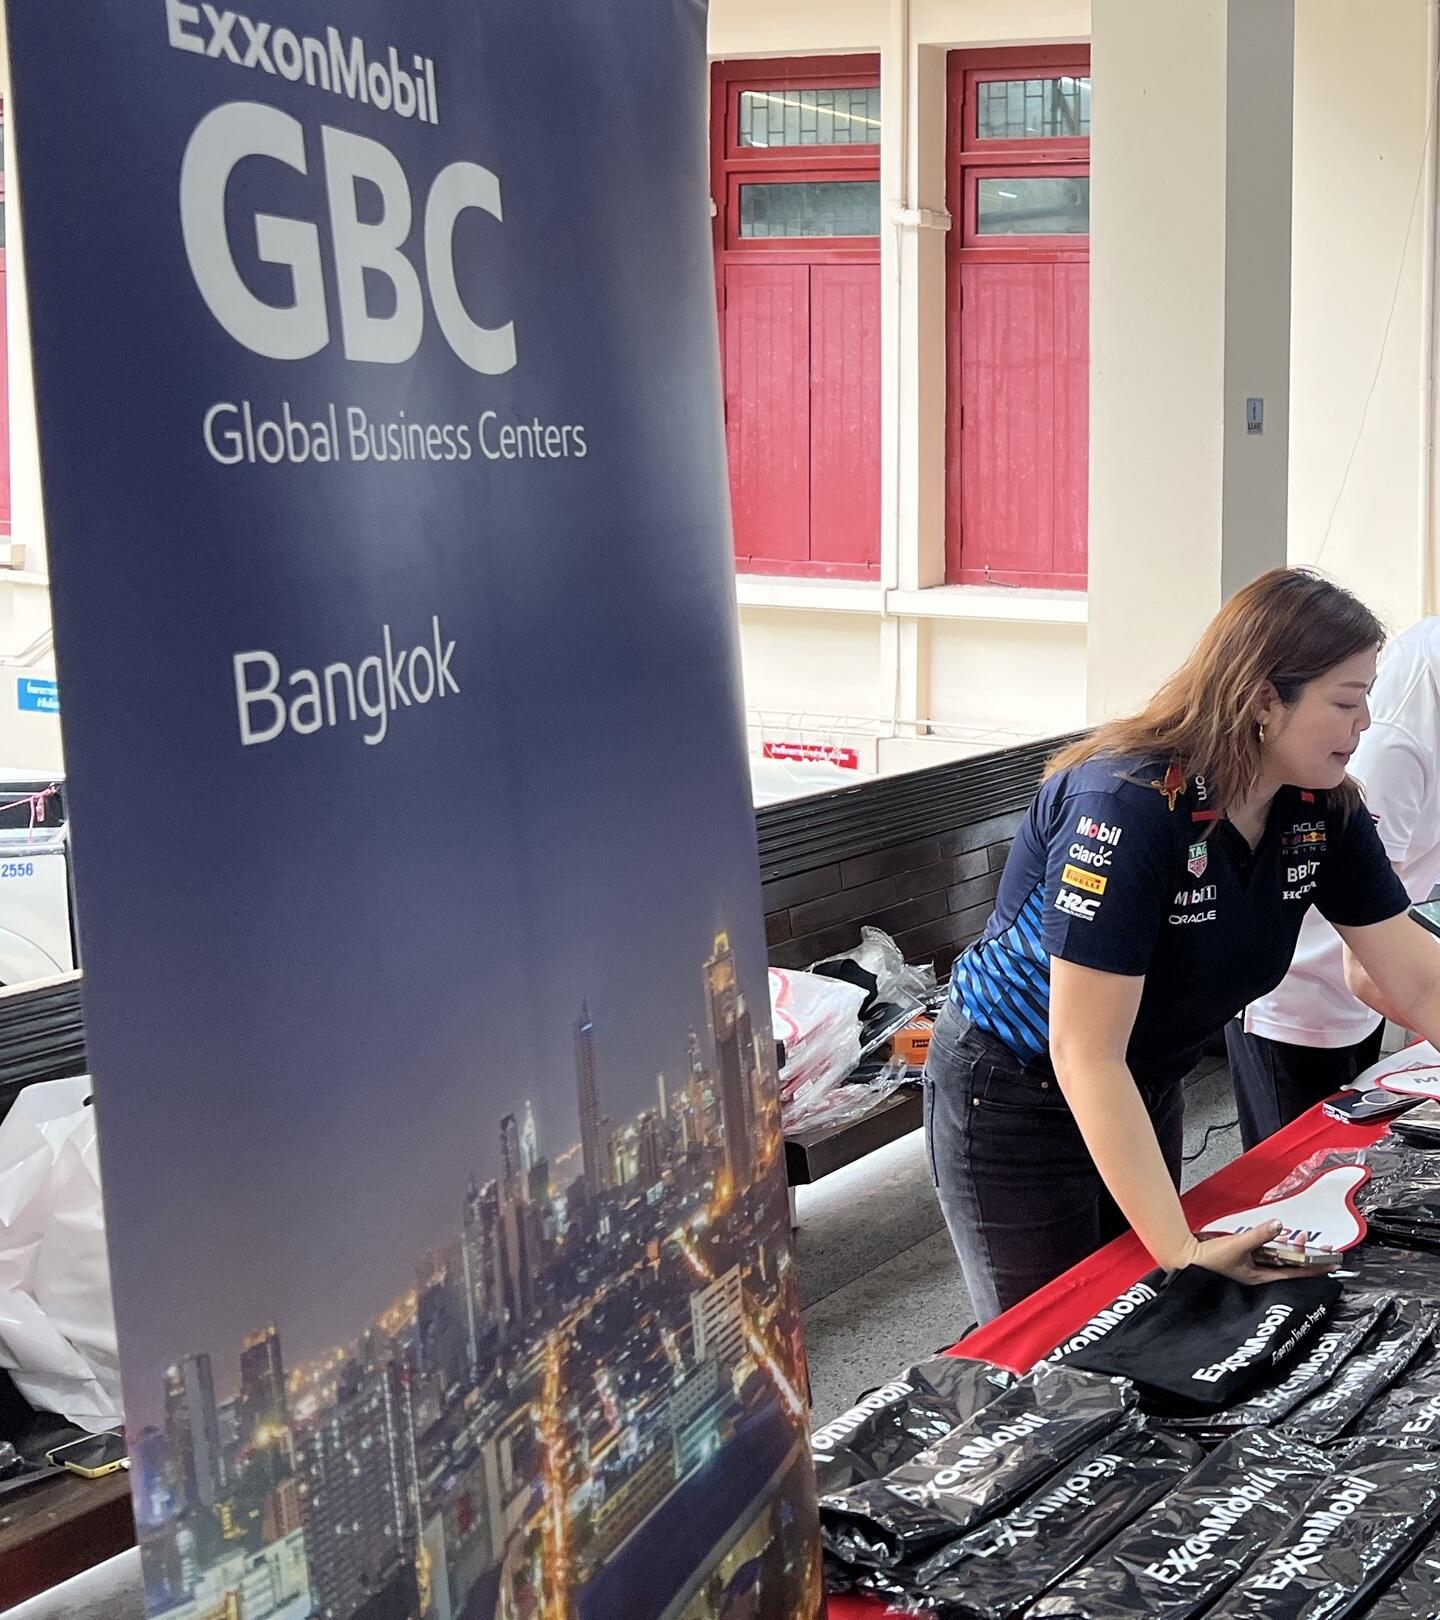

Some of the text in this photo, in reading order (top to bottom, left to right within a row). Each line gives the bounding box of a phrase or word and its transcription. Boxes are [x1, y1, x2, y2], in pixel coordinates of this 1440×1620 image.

[165, 0, 440, 126] ExxonMobil
[179, 101, 518, 375] GBC
[203, 400, 588, 465] Global Business Centers
[232, 615, 460, 747] Bangkok
[1069, 843, 1110, 868] Claro
[1076, 816, 1122, 846] Mobil
[1056, 889, 1101, 917] HRC
[1168, 910, 1217, 925] ORACLE
[1047, 1282, 1158, 1361] onMobil
[808, 1381, 914, 1463] onMobil
[1143, 1472, 1277, 1584] ExxonMobil
[1250, 1476, 1378, 1590] ExxonMobil
